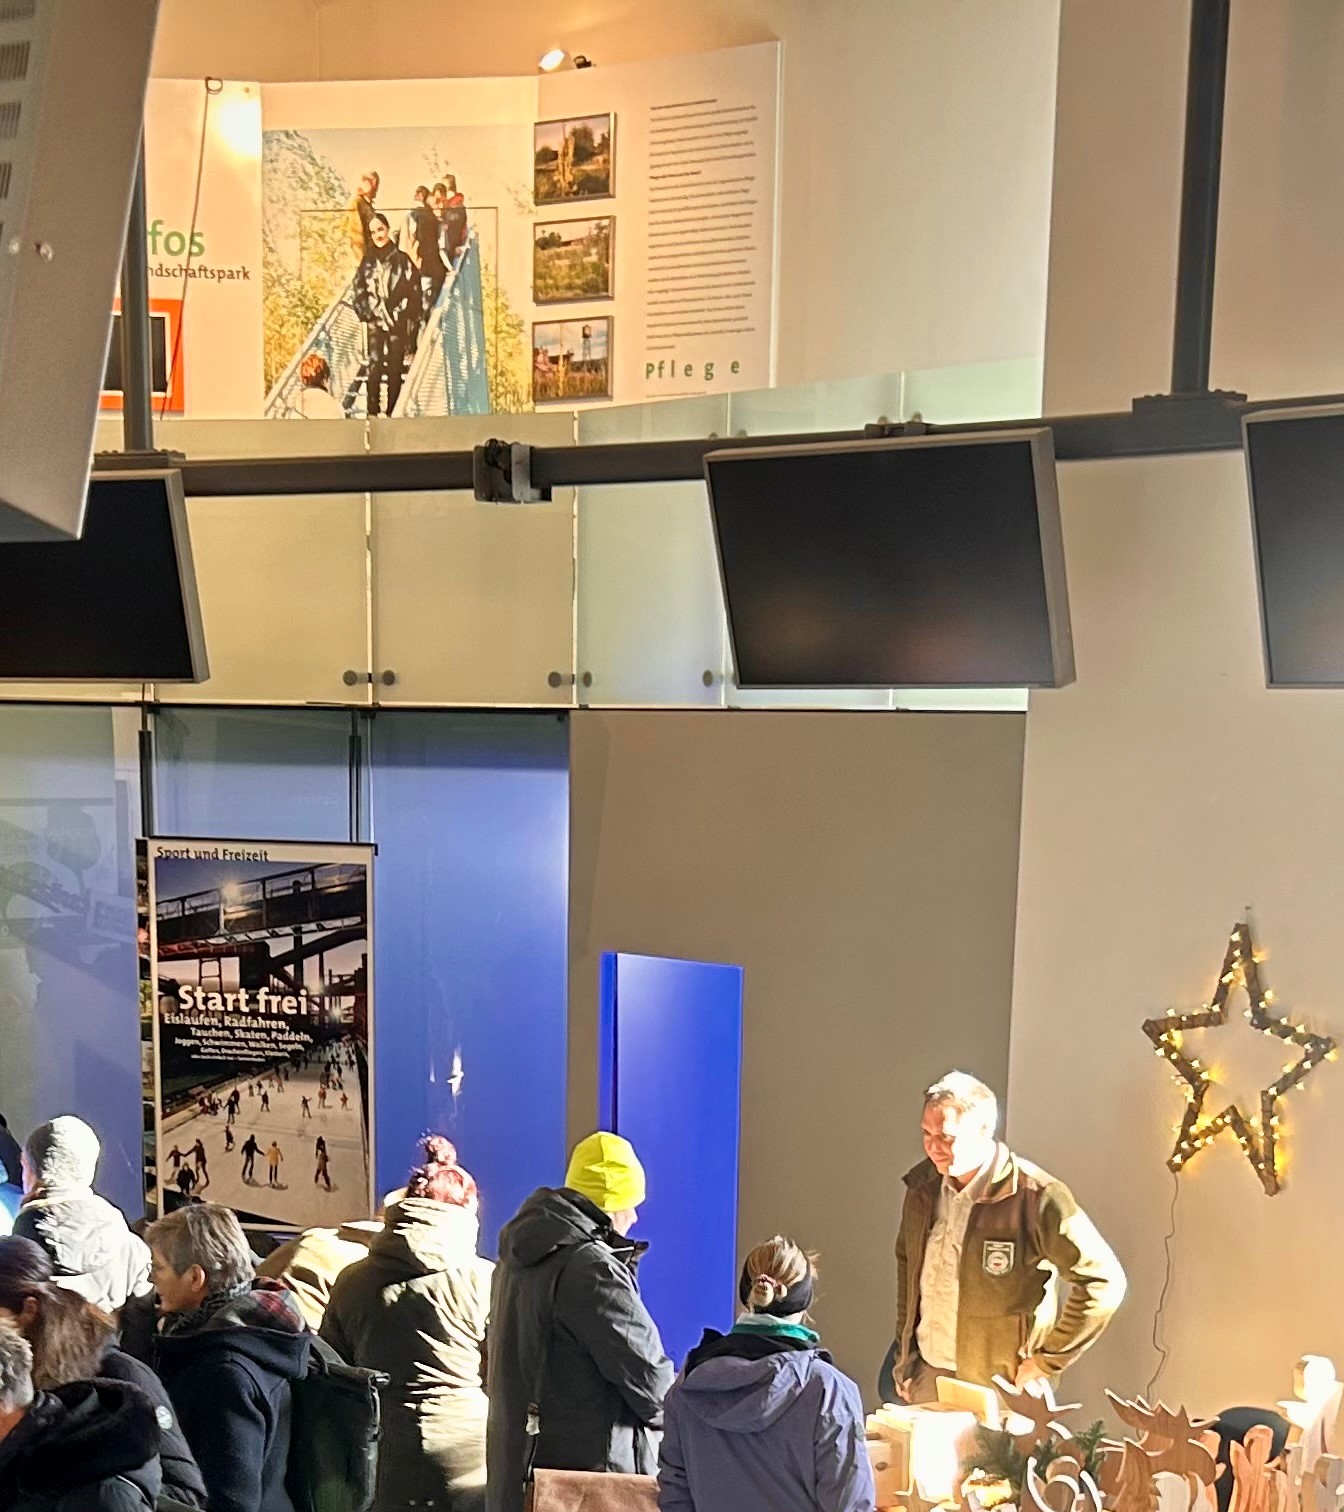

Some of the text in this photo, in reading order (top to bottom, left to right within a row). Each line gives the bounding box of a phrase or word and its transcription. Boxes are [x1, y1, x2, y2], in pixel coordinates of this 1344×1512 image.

[147, 219, 205, 257] fos
[147, 263, 251, 284] ndschaftspark
[156, 846, 269, 862] Sport und Freizeit
[178, 984, 308, 1015] Start frei
[164, 1013, 290, 1031] Eislaufen, Radfahren,
[190, 1027, 313, 1044] Tauchen, Skaten, Paddeln,
